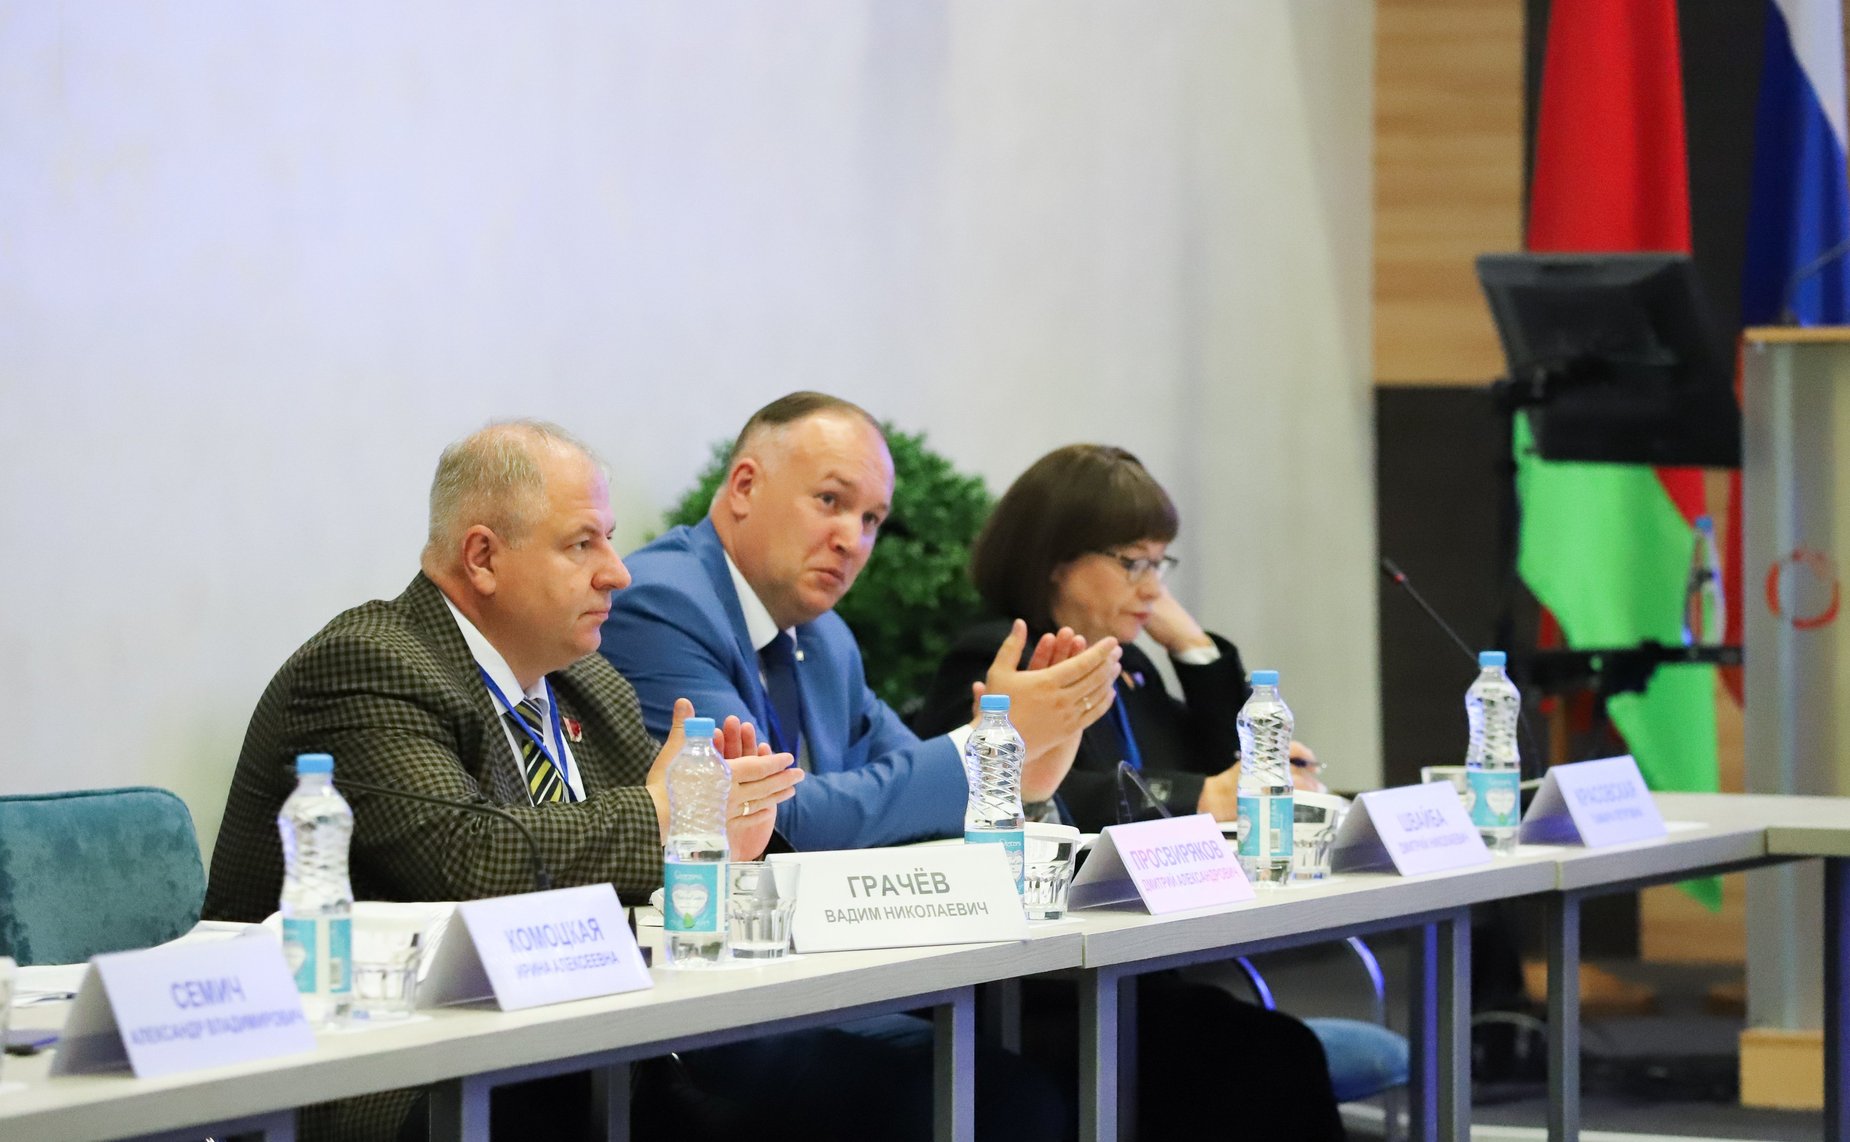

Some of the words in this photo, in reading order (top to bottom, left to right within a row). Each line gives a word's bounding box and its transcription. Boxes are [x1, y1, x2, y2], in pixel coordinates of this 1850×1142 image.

[1129, 840, 1225, 871] ПРОСВИРЯКОВ
[847, 867, 951, 898] ГРАЧЁВ
[1141, 873, 1176, 892] ДМИТРИЙ
[1177, 867, 1240, 887] АЛЕКСАНДРОВИЧ
[824, 906, 882, 924] ВАДИМ
[884, 901, 990, 920] НИКОЛАЕВИЧ
[504, 917, 605, 952] КОМОЦКАЯ
[515, 961, 551, 980] ИРИНА
[552, 951, 621, 973] АЛЕКСЕЕВНА
[169, 975, 246, 1009] СЕМИЧ
[130, 1020, 202, 1045] АЛЕКСАНДР
[207, 1009, 304, 1036] ВЛАДИМИРОВИЧ
